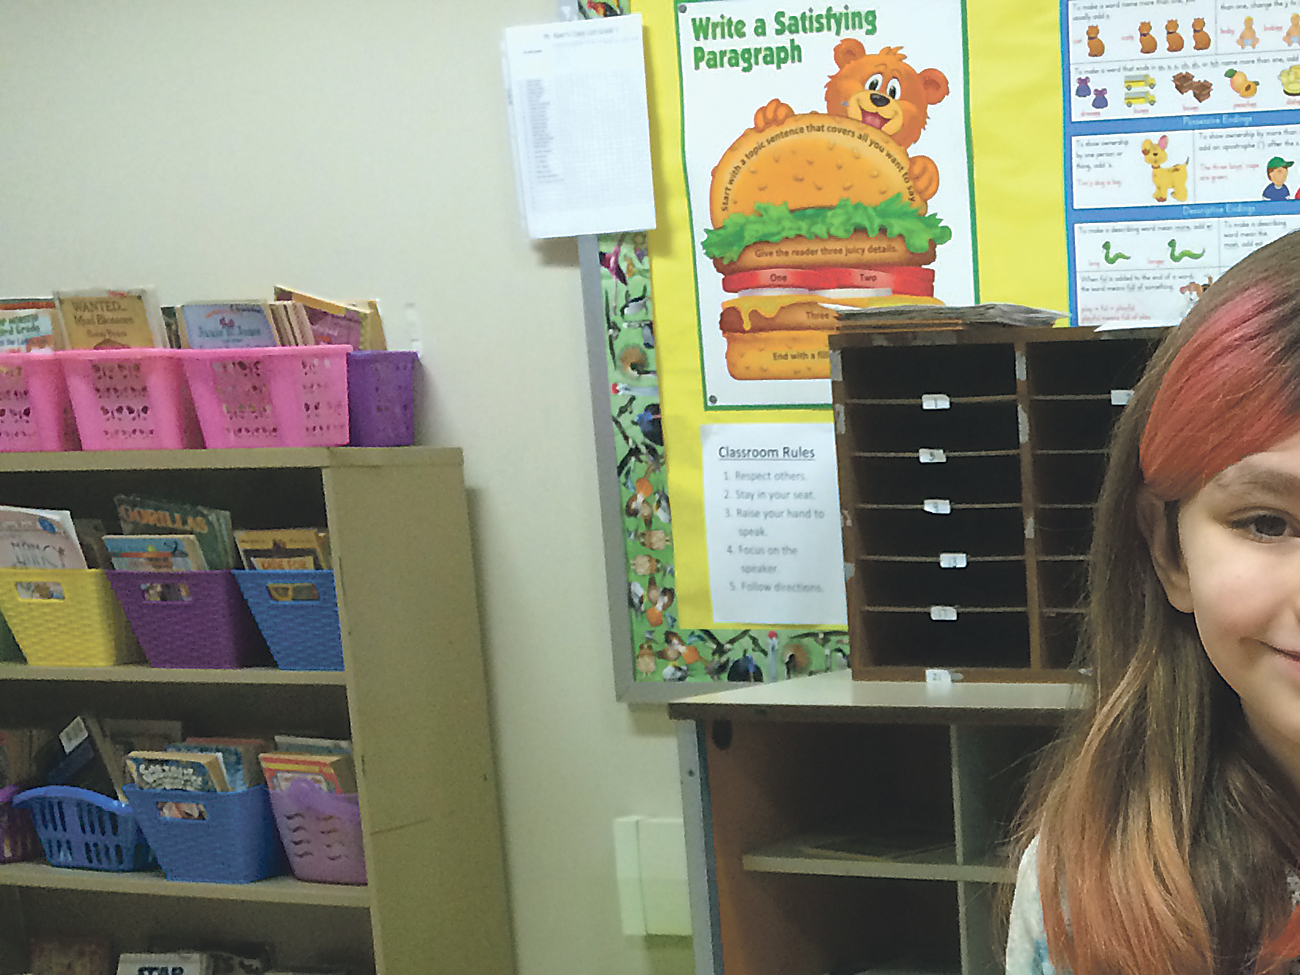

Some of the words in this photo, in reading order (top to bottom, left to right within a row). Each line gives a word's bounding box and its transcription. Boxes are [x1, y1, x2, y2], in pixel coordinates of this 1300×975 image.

[691, 14, 746, 41] Write
[754, 18, 766, 37] a
[775, 5, 877, 36] Satisfying
[693, 39, 802, 72] Paragraph
[1223, 114, 1253, 125] Endings
[721, 186, 731, 211] Start
[729, 166, 741, 186] with
[745, 141, 766, 160] topic
[766, 126, 805, 145] sentence
[806, 124, 825, 133] that
[827, 126, 856, 138] covers
[857, 132, 869, 143] all
[868, 138, 885, 154] you
[886, 151, 904, 173] want
[902, 172, 910, 184] to
[907, 185, 916, 203] say
[1226, 204, 1256, 215] Endings
[755, 249, 774, 258] Give
[776, 249, 789, 257] the
[791, 247, 818, 257] reader
[821, 246, 843, 255] three
[845, 245, 866, 256] juicy
[868, 244, 897, 254] details.
[770, 273, 787, 282] One
[860, 273, 877, 282] Two
[806, 311, 830, 320] Three
[773, 352, 788, 361] End
[791, 351, 809, 360] with
[719, 446, 779, 459] Classroom
[783, 446, 816, 459] Rules
[735, 471, 771, 482] Respect
[736, 490, 755, 501] Stay
[757, 490, 766, 499] in
[770, 492, 790, 501] your
[736, 508, 760, 519] Raise
[763, 510, 784, 520] your
[787, 508, 812, 519] hand
[814, 509, 825, 519] to
[738, 545, 766, 555] Focus
[767, 547, 779, 555] on
[781, 546, 798, 555] the
[741, 581, 772, 592] Follow
